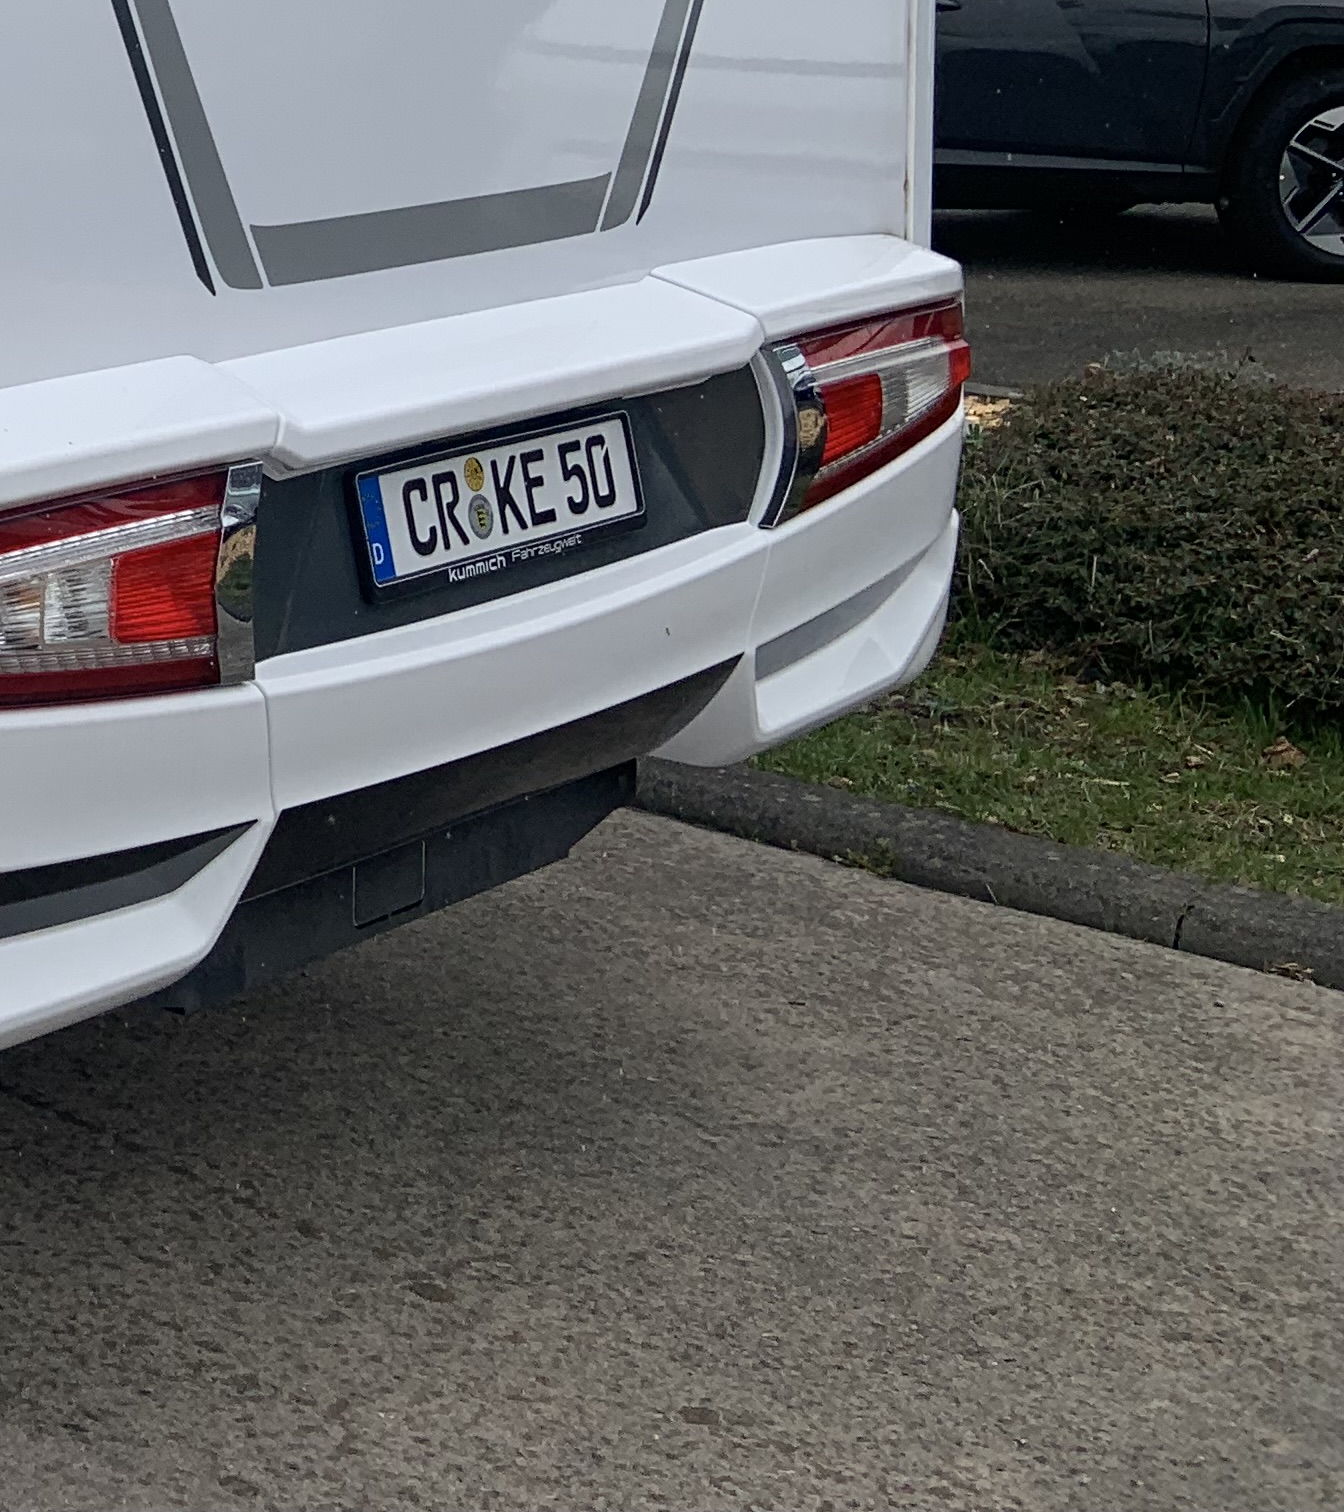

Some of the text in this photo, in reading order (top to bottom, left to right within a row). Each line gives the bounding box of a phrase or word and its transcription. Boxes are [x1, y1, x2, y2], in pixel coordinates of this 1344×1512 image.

[402, 434, 616, 556] CR KE 50
[372, 542, 385, 565] D
